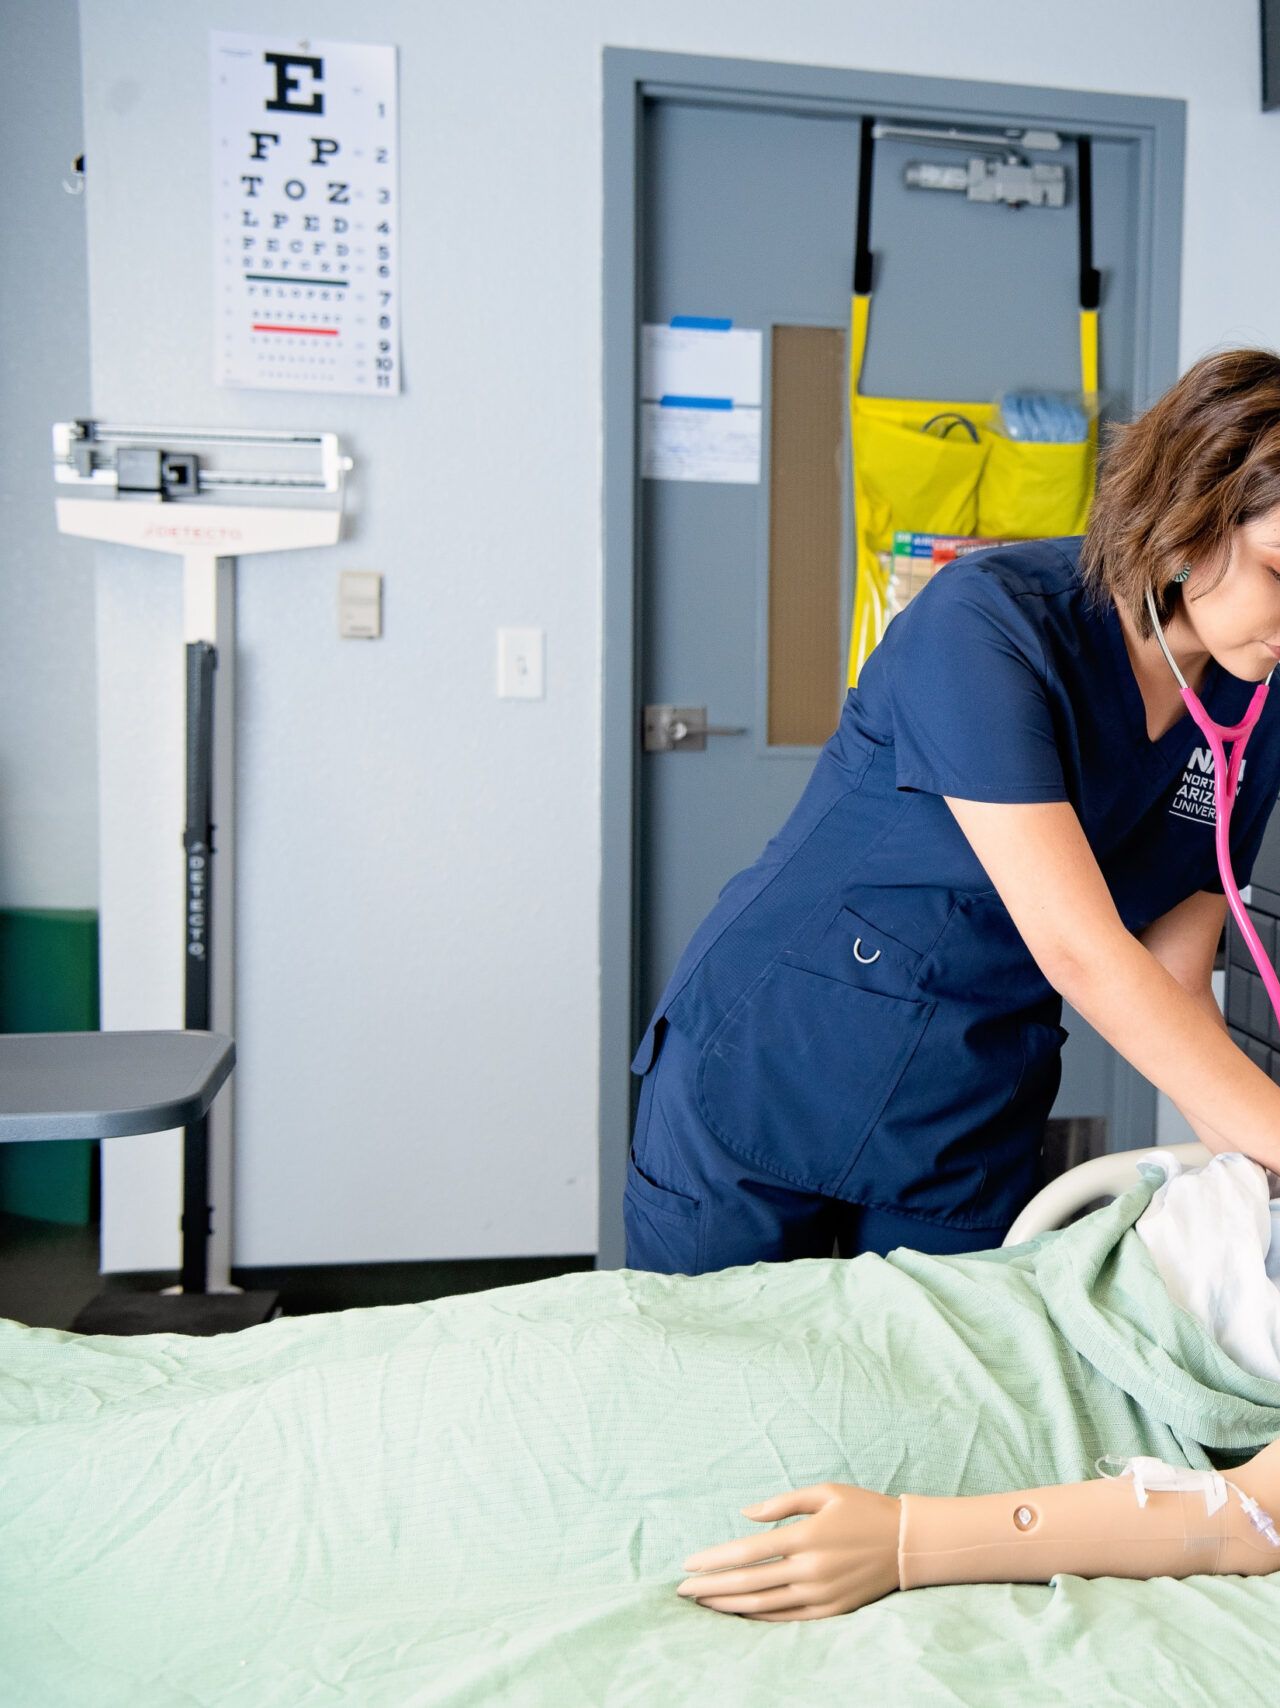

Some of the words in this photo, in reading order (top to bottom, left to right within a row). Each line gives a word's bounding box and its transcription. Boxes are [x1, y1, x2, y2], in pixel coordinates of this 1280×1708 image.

[264, 52, 324, 116] E
[378, 102, 386, 118] 1
[376, 149, 388, 164] 2
[377, 189, 390, 205] 3
[376, 221, 390, 237] 4
[377, 245, 390, 261] 5
[377, 263, 390, 278] 6
[379, 290, 391, 306] 7
[378, 338, 391, 353] 9
[375, 356, 394, 372] 10
[1176, 784, 1217, 806] ARIZ
[188, 855, 206, 956] DETECTO
